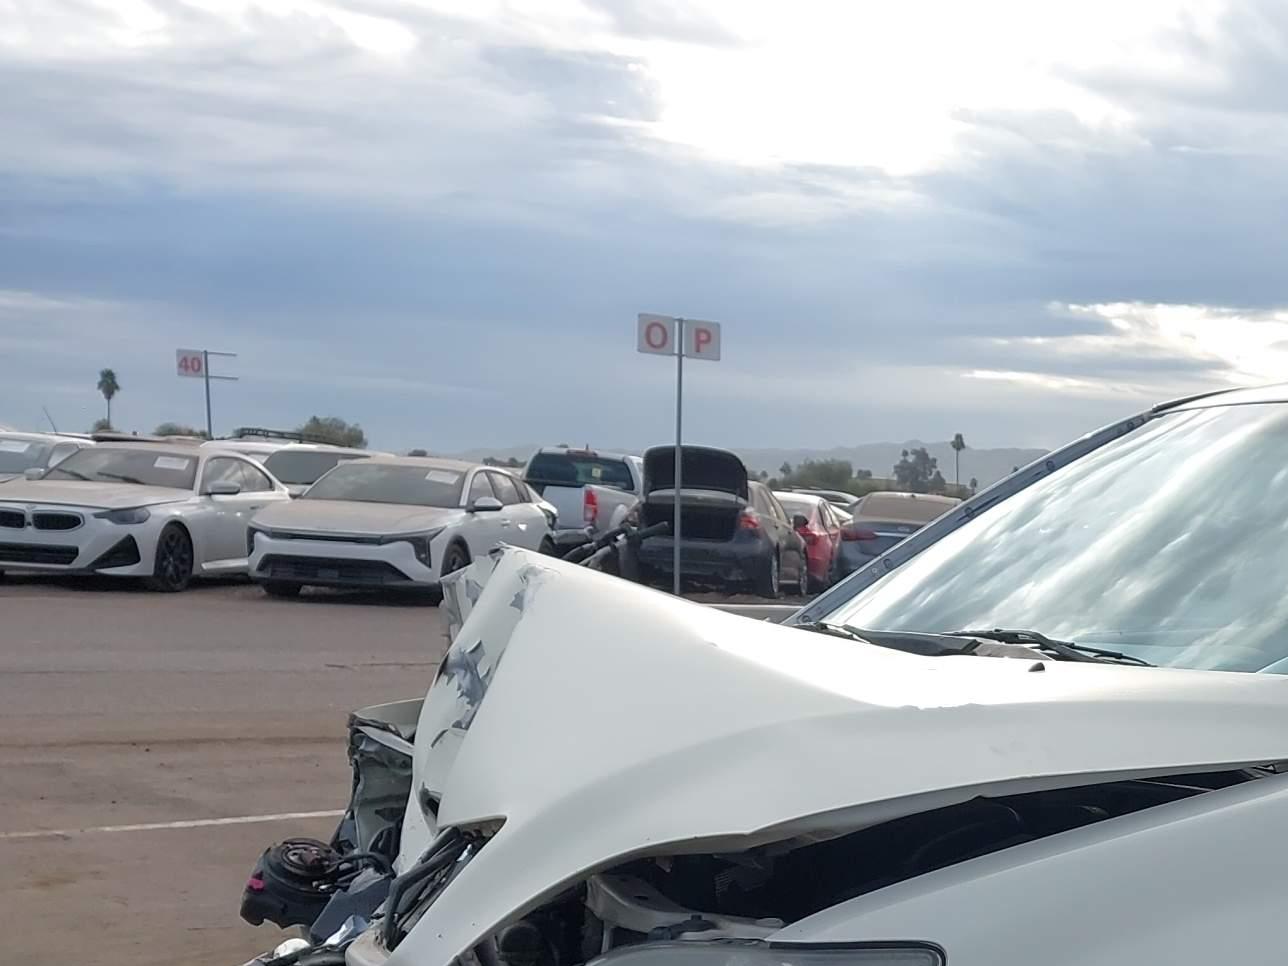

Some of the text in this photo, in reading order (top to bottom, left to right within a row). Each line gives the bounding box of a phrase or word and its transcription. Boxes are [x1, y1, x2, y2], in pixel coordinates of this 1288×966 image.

[645, 322, 668, 349] O
[695, 327, 712, 353] P
[178, 356, 202, 373] 40
